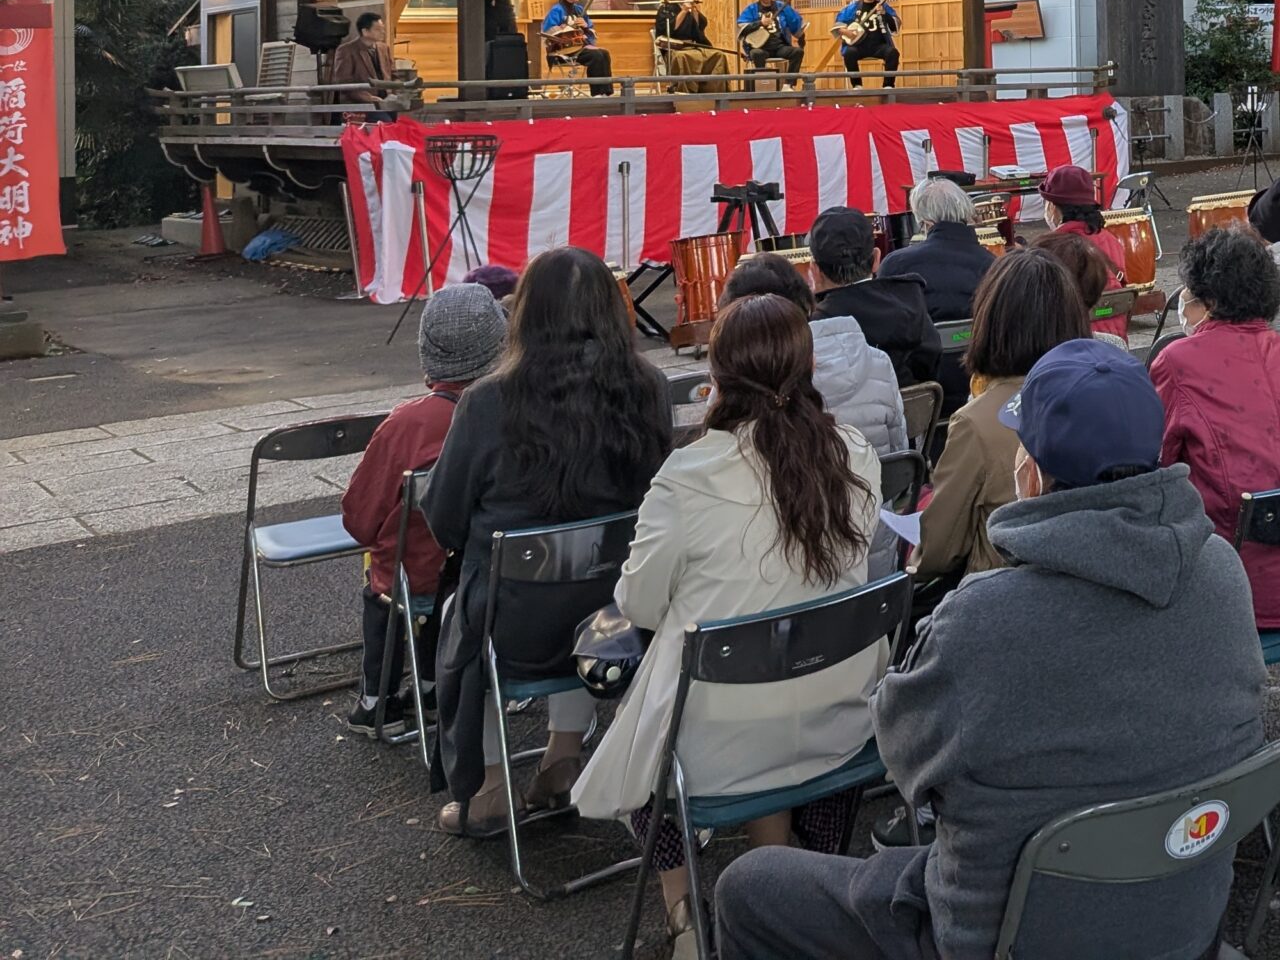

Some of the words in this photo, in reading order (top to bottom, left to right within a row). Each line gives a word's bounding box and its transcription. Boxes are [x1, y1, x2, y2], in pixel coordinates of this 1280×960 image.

[0, 59, 28, 72] 一位
[0, 77, 33, 250] 稲荷大明神
